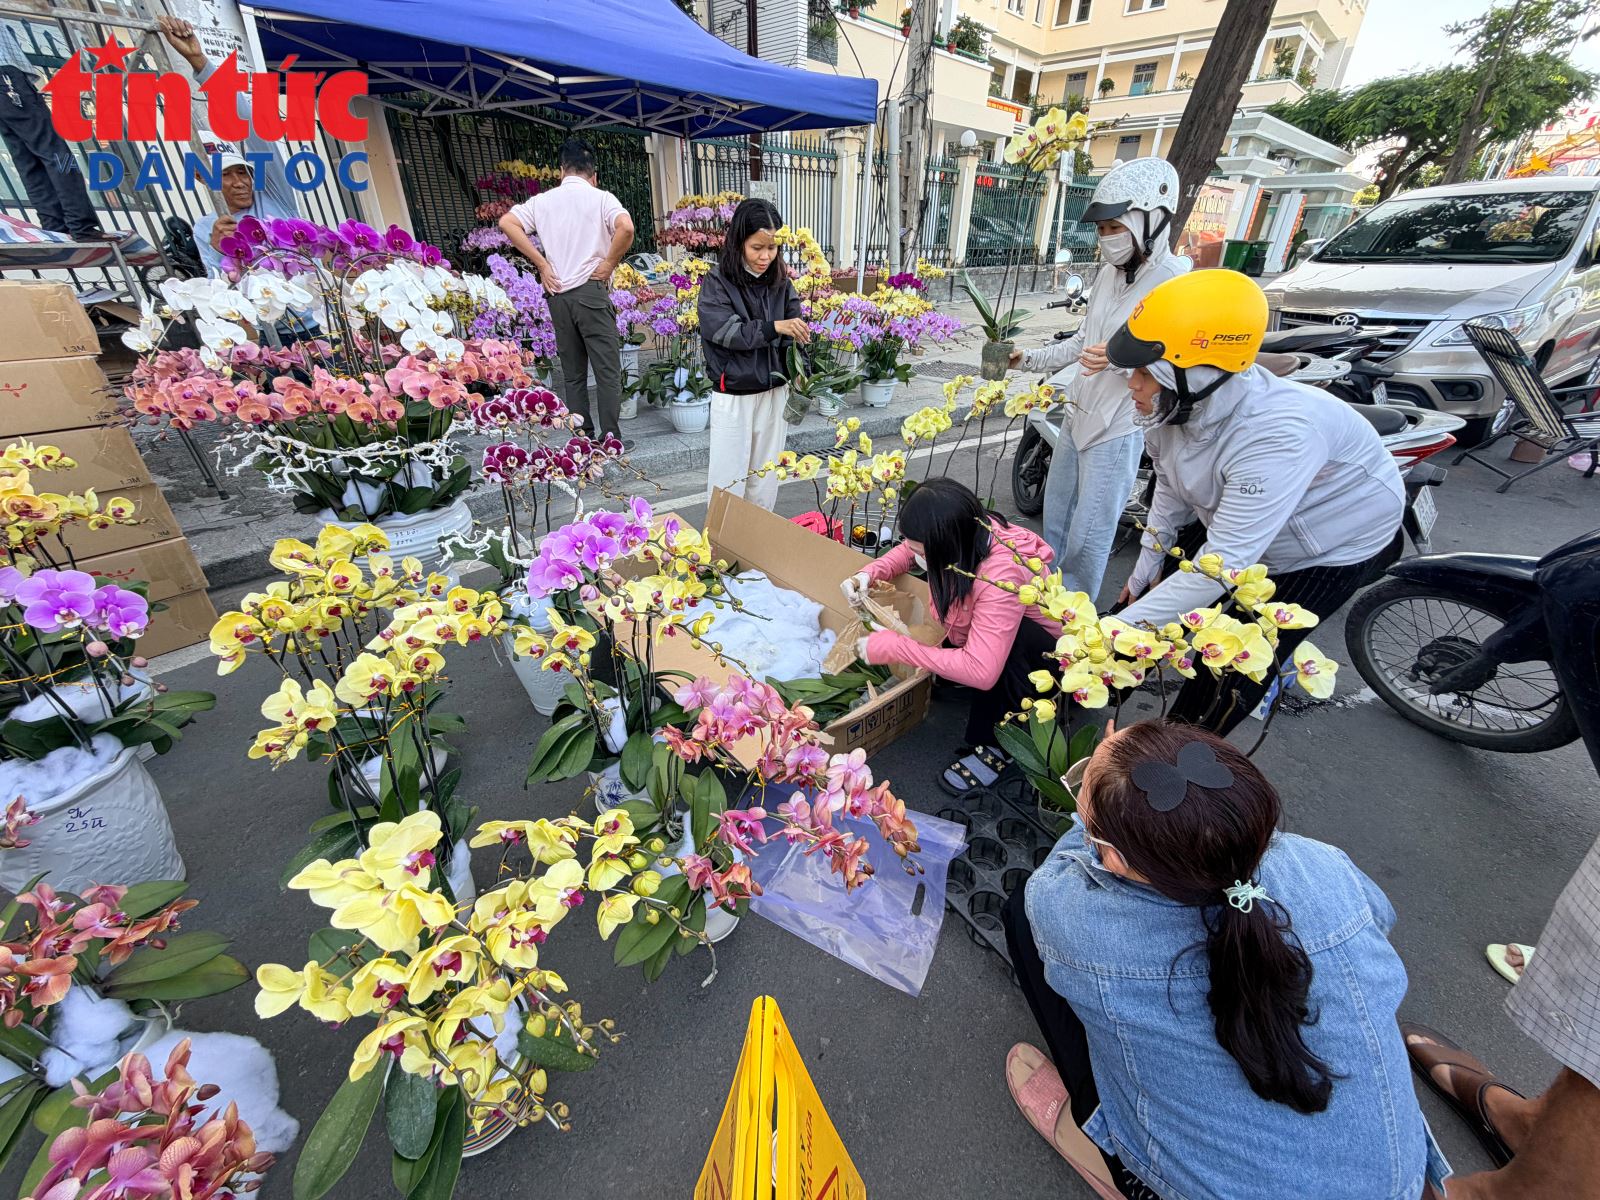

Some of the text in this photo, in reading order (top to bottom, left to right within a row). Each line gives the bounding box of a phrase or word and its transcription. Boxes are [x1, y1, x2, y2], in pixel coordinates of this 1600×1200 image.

[1213, 333, 1252, 342] PISEN
[63, 345, 85, 353] 1.3M
[1240, 484, 1265, 495] 50+
